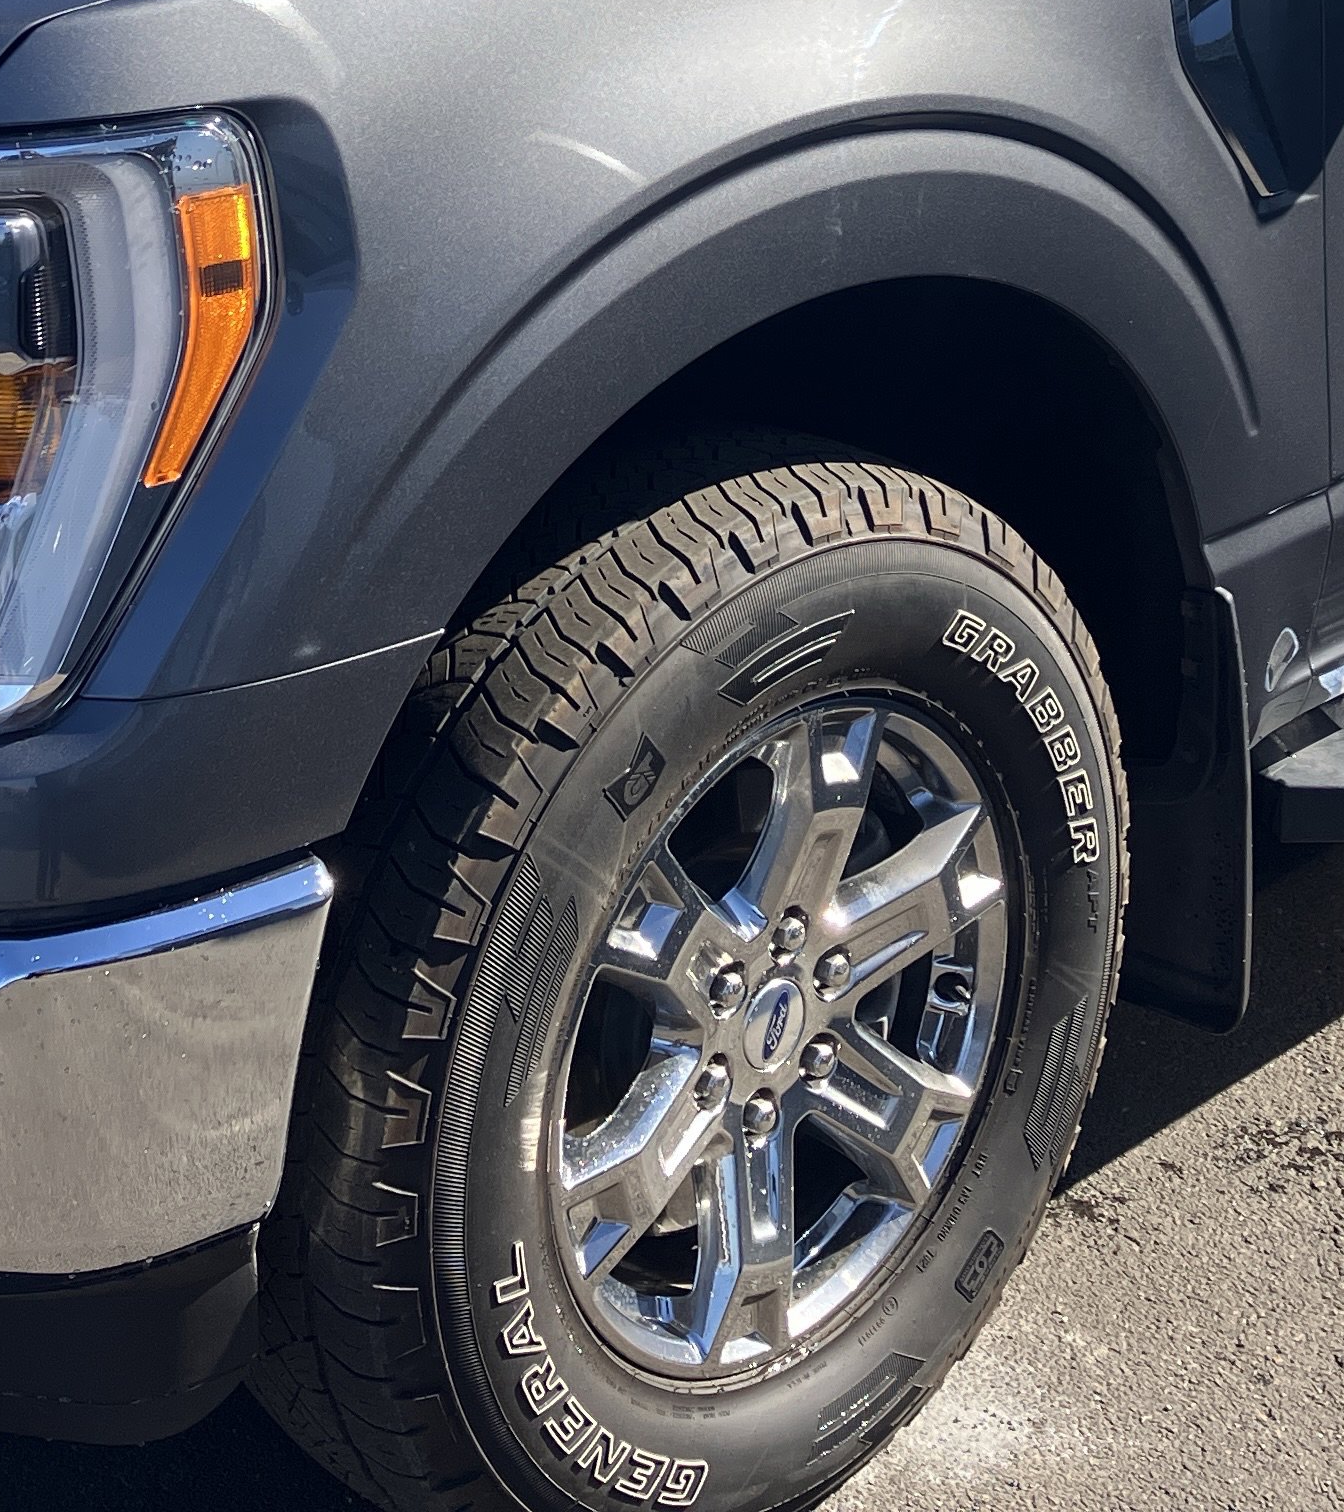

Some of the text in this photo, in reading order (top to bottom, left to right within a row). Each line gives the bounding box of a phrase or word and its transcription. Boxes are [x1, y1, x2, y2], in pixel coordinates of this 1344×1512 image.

[942, 608, 1100, 865] GRABBER
[1085, 868, 1100, 934] APT
[766, 1002, 789, 1051] Ford
[493, 1241, 708, 1506] GENERAL
